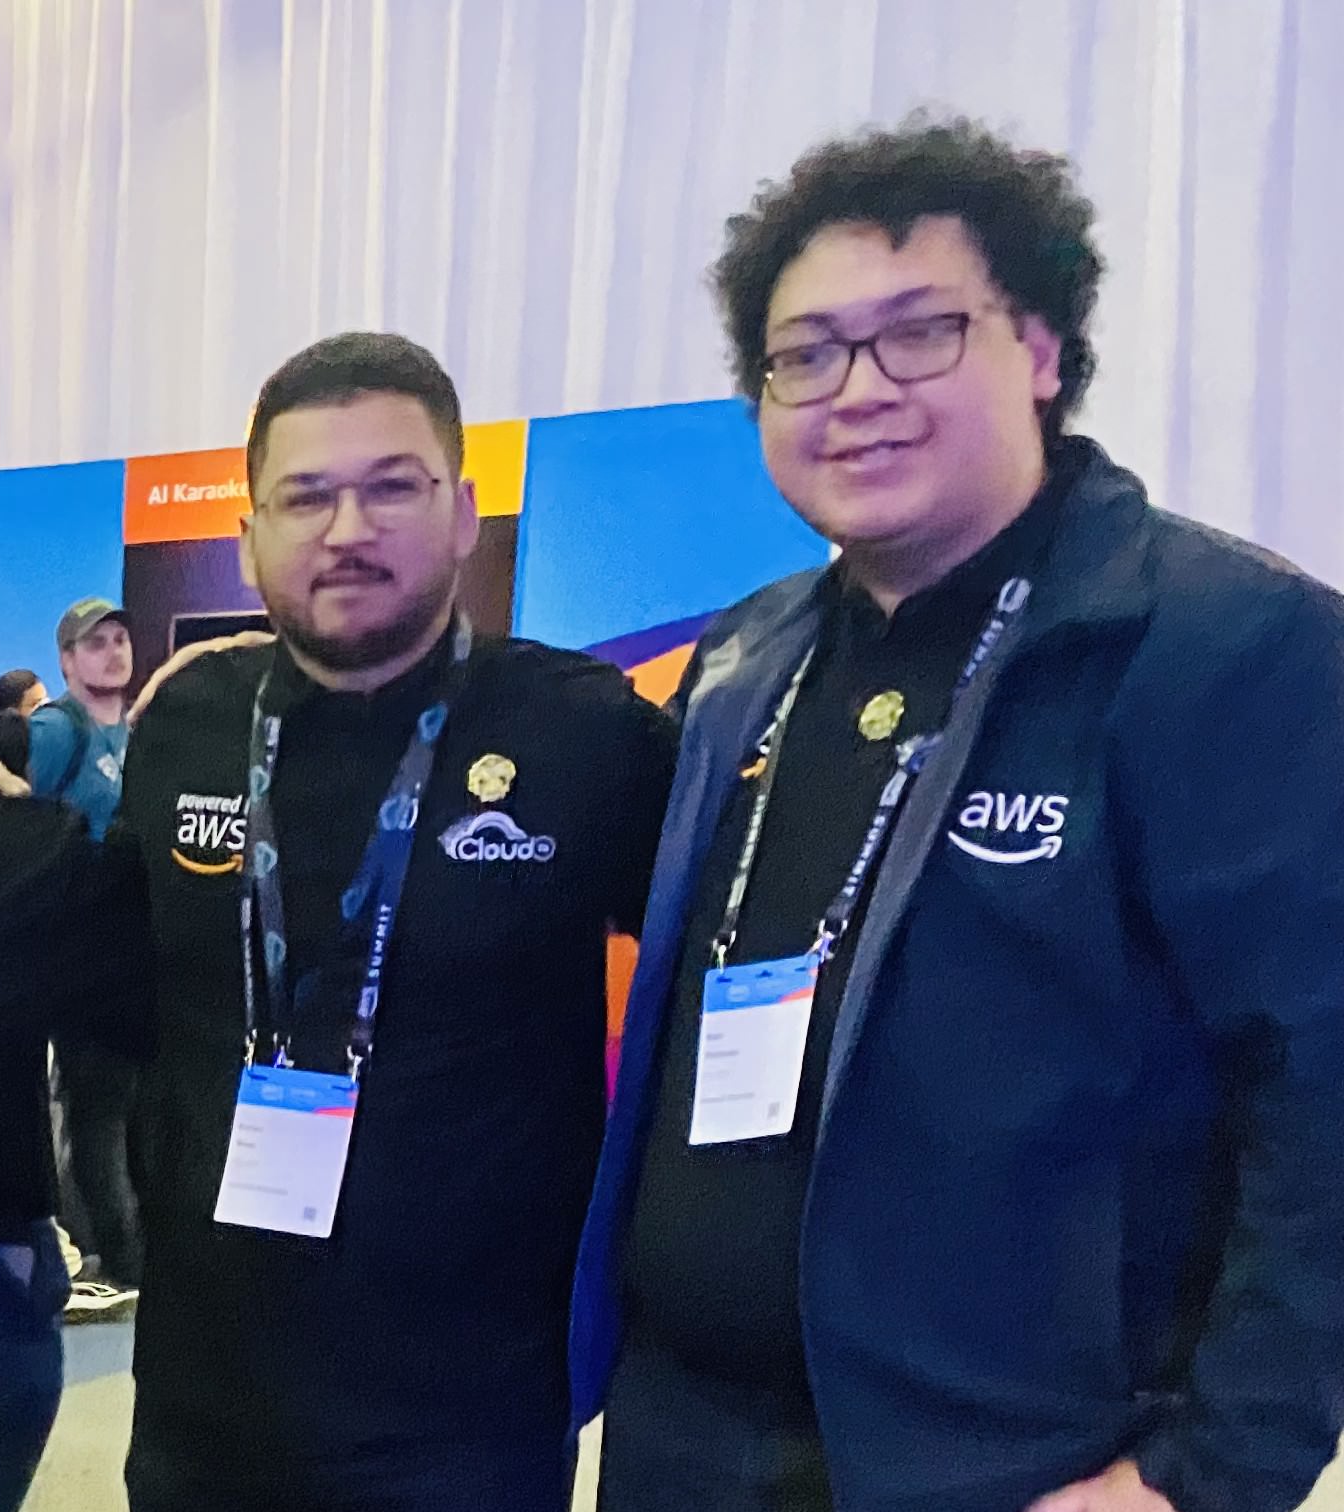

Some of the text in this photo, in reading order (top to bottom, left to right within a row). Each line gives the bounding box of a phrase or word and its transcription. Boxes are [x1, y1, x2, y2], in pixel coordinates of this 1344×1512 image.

[148, 483, 168, 505] AI
[177, 793, 243, 814] powered
[960, 790, 1069, 834] aws
[178, 813, 248, 850] aws
[368, 904, 392, 977] SUMMIT
